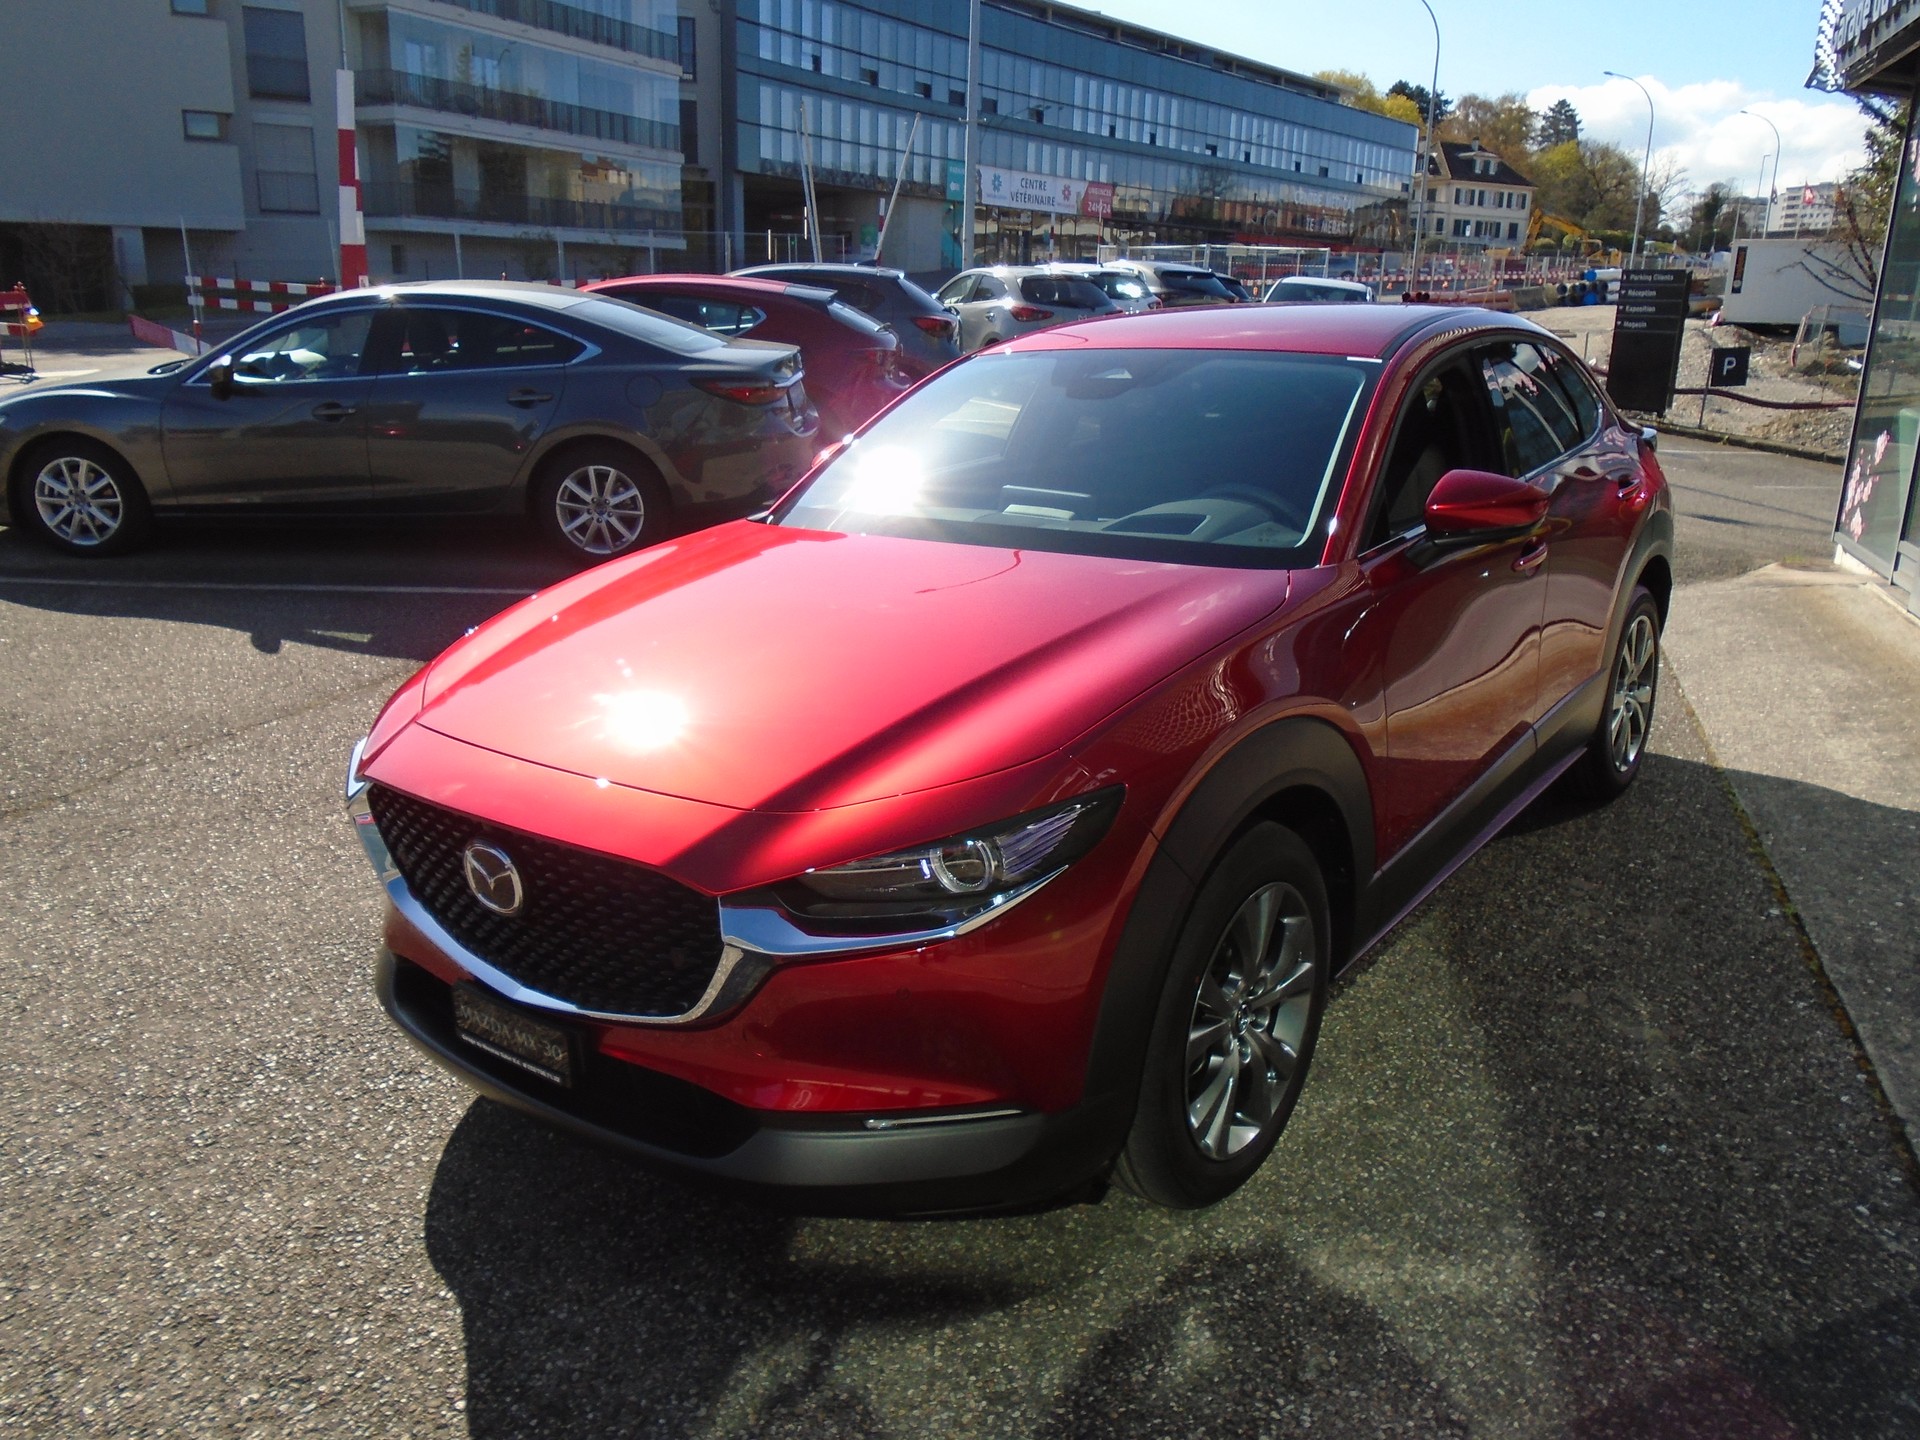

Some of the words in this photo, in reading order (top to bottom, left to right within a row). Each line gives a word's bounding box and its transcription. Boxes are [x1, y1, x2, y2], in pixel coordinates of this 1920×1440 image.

[1020, 177, 1047, 191] CENTRE
[1010, 189, 1056, 207] VÉTÉRINAIRE
[1630, 274, 1652, 282] Parking
[1628, 289, 1657, 297] Réception
[1625, 305, 1656, 313] Exposition
[1623, 321, 1647, 329] Magasin
[1723, 356, 1737, 376] P
